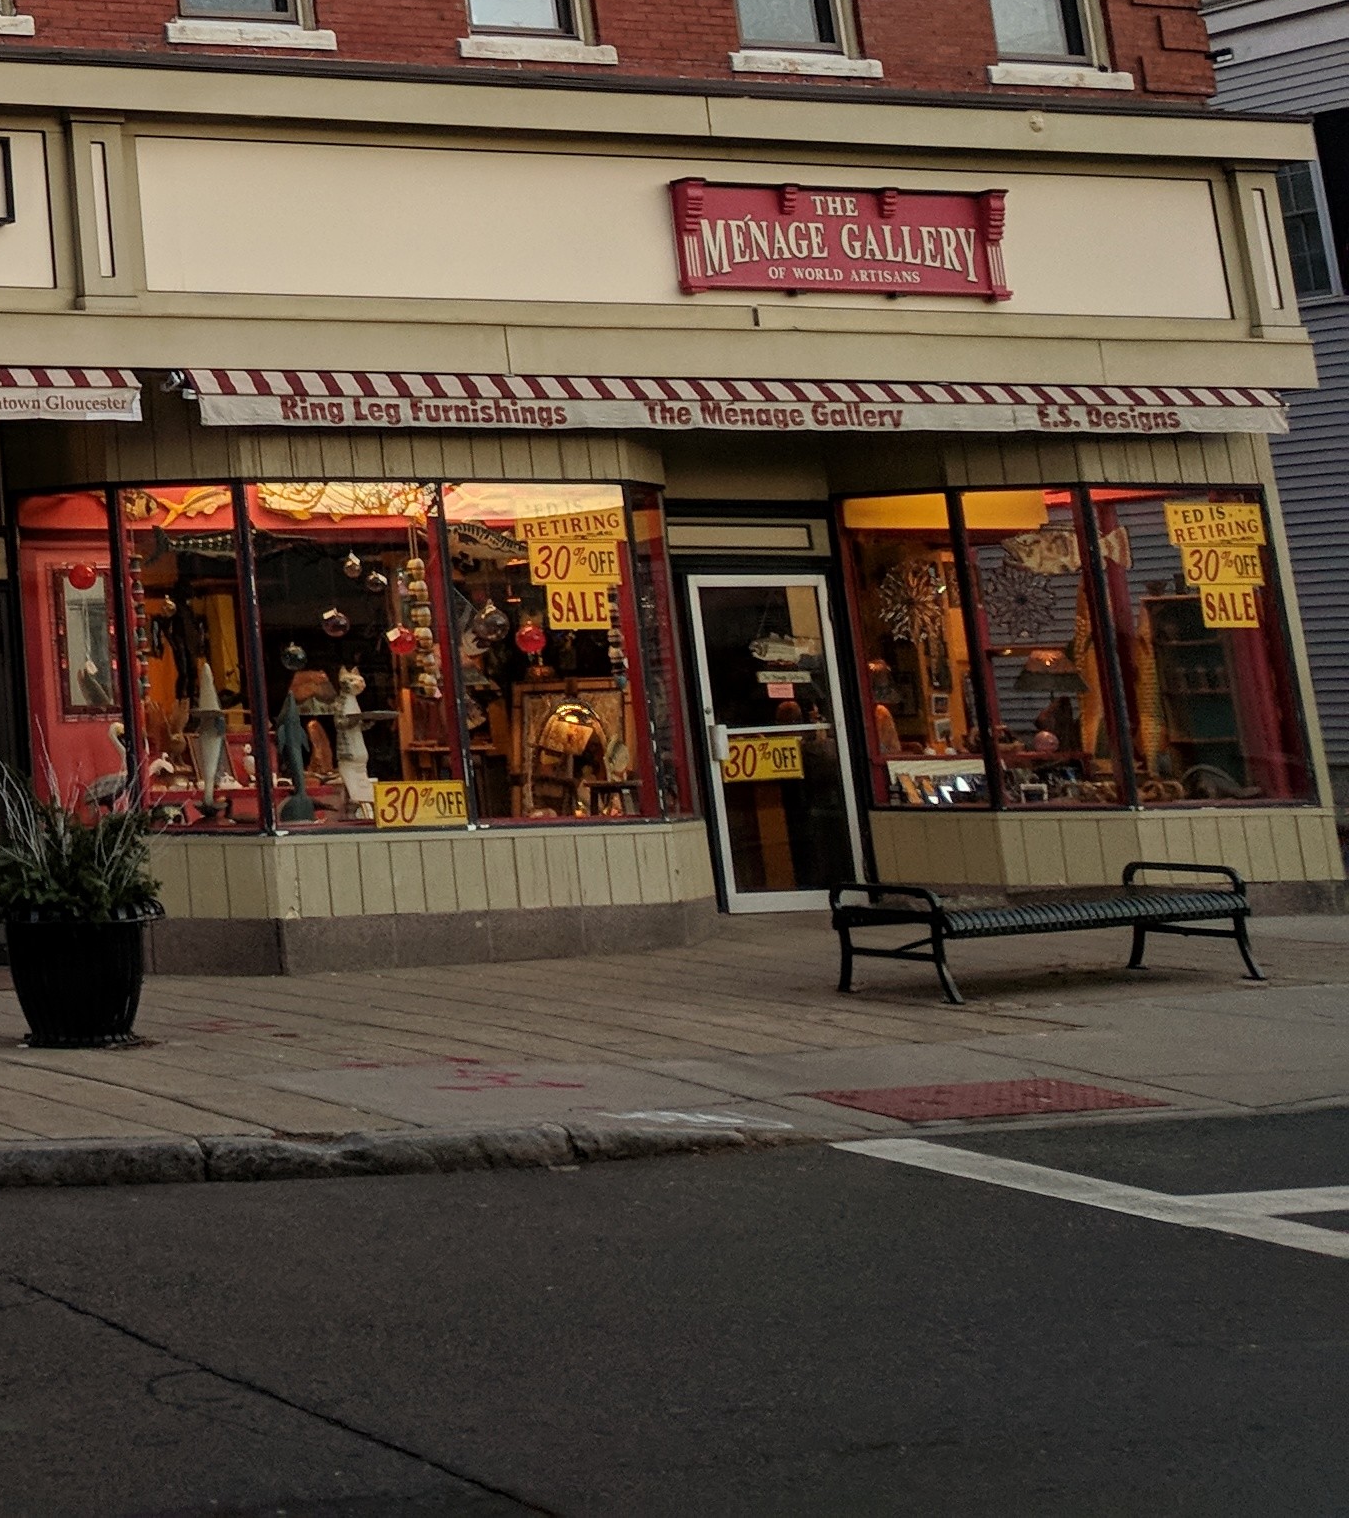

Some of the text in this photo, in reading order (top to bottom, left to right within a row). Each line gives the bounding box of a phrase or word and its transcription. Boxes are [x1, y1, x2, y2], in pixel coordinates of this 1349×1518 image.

[810, 195, 859, 217] THE
[840, 222, 979, 284] GALLERY
[767, 266, 921, 285] OF WORLD ARTISANS
[45, 395, 128, 411] Gloucester
[279, 396, 1182, 433] Ring Leg Furnishings The Ménage Gallery E.S. Designs
[522, 512, 620, 538] RETIRING
[1181, 505, 1227, 525] ED IS
[1173, 518, 1259, 543] RETIRING
[587, 550, 616, 574] OFF
[1233, 553, 1258, 576] OFF
[551, 590, 608, 623] SALE
[1205, 591, 1256, 622] SALE
[772, 747, 797, 769] OFF
[435, 791, 464, 816] OFF
